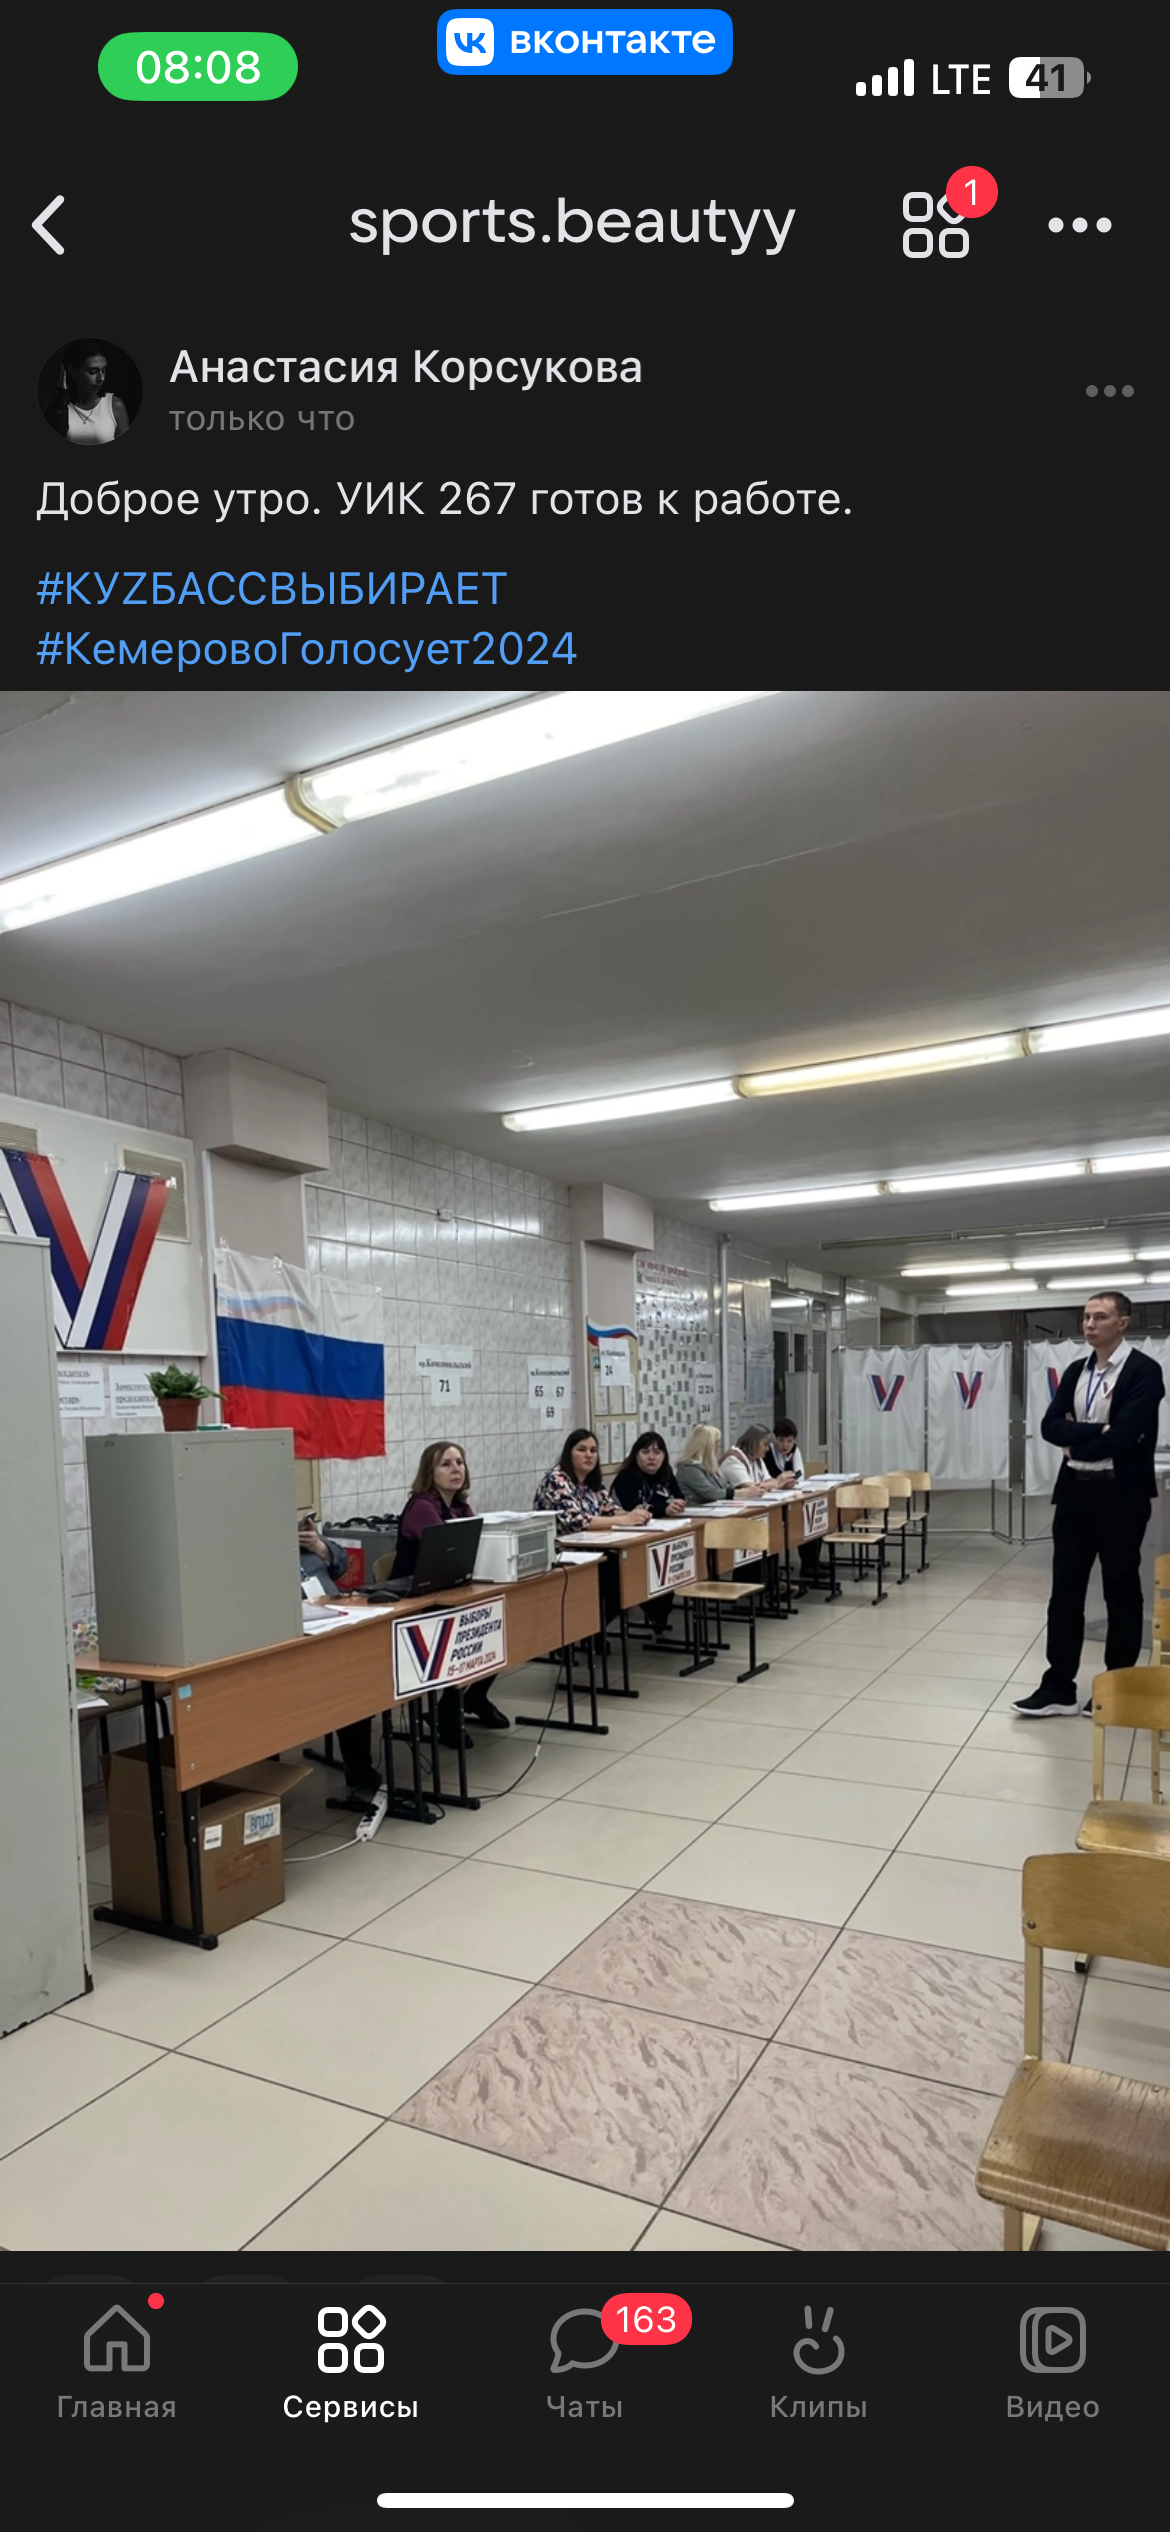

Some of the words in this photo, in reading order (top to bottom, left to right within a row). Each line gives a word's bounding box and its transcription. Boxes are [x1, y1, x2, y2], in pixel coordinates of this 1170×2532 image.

[439, 1379, 451, 1393] 71
[534, 1385, 544, 1398] 65
[555, 1386, 565, 1398] 67
[545, 1406, 555, 1418] 69
[459, 1606, 493, 1628] ВЫБОРЫ
[455, 1619, 502, 1645] ПРЕЗИДЕНТА
[450, 1641, 483, 1662] РОССИИ
[466, 1657, 484, 1671] МАРТА
[483, 1651, 496, 1664] 2024
